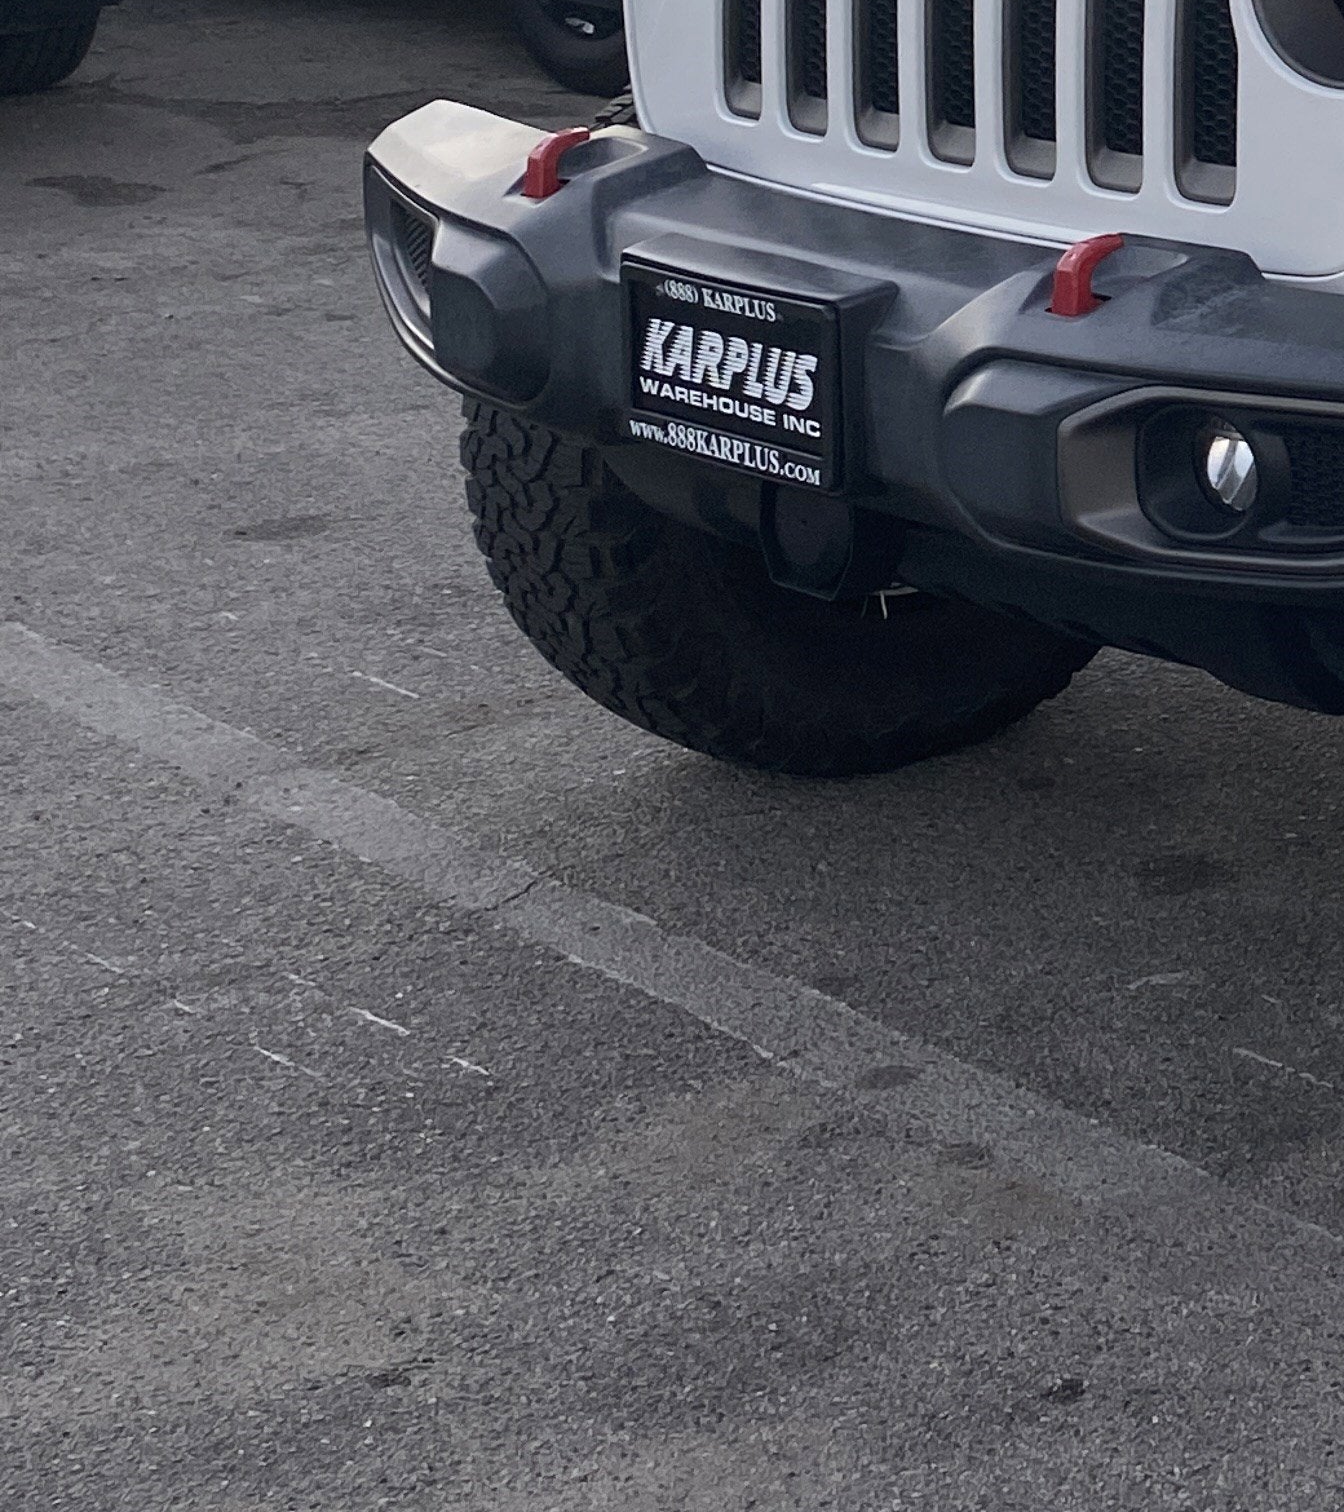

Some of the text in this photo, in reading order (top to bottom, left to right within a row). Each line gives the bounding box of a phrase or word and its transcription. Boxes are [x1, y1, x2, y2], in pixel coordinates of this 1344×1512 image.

[663, 279, 776, 323] (888) KARPLUS
[639, 317, 818, 411] KARPLUS
[639, 376, 822, 438] WAREHOUSE INC
